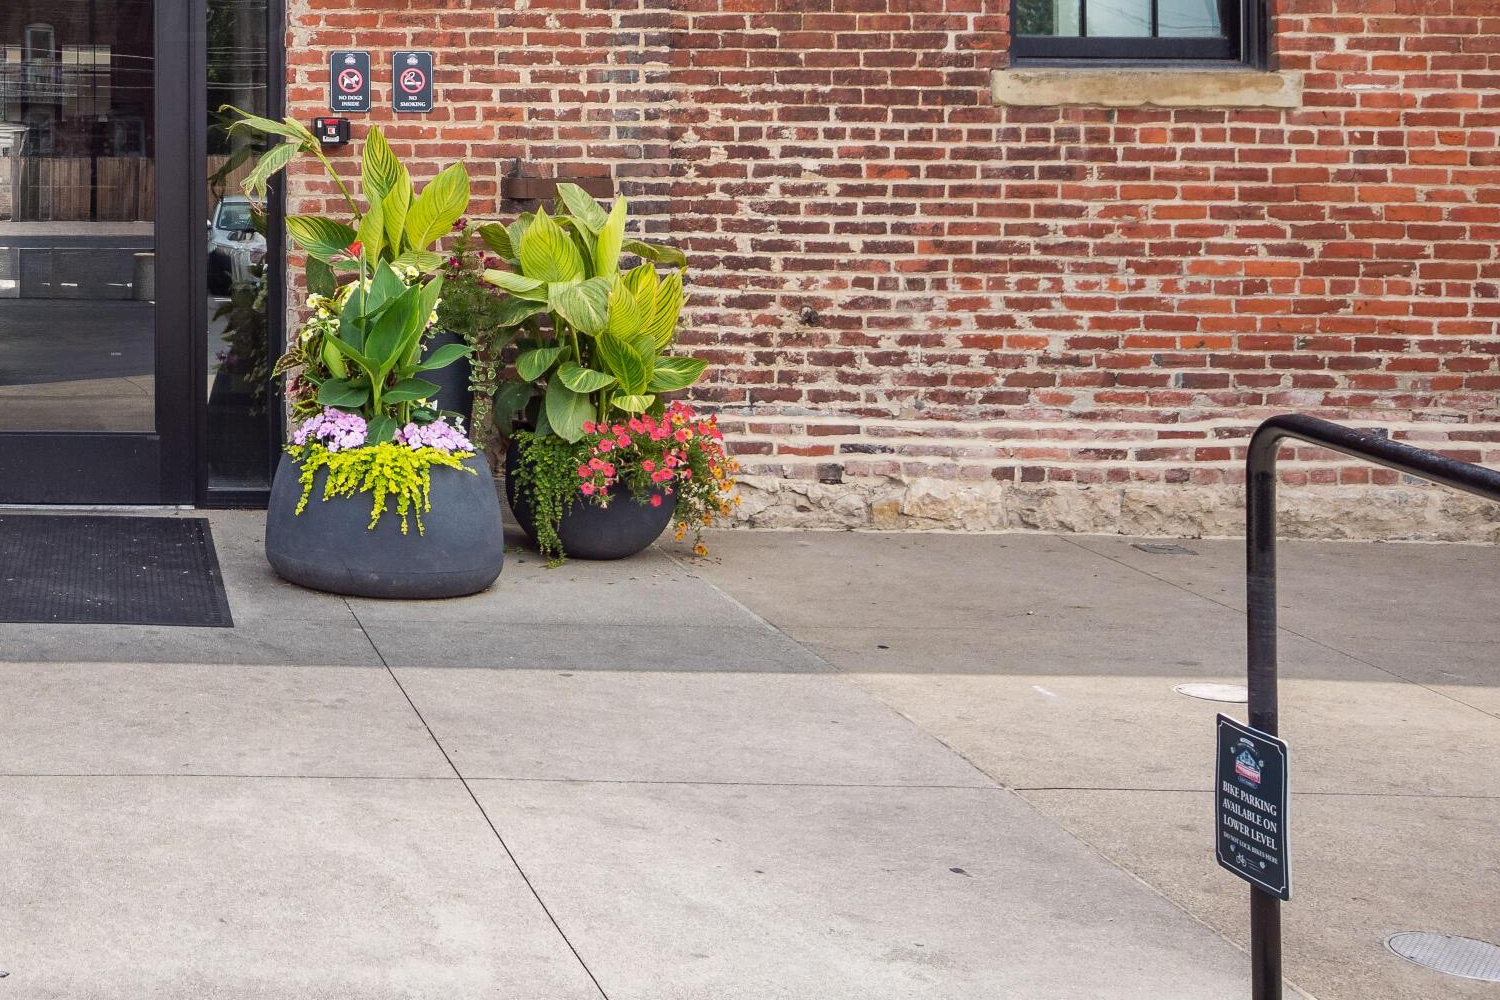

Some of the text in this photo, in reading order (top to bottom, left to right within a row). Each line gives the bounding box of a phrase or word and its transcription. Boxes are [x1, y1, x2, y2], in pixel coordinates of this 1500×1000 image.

[1222, 780, 1277, 817] BIKE PARKING
[1222, 797, 1277, 834] AVAILABLE ON
[1223, 813, 1278, 851] LOWER LEVEL
[1223, 830, 1279, 865] DO NOT LOCK BIKES HERE
